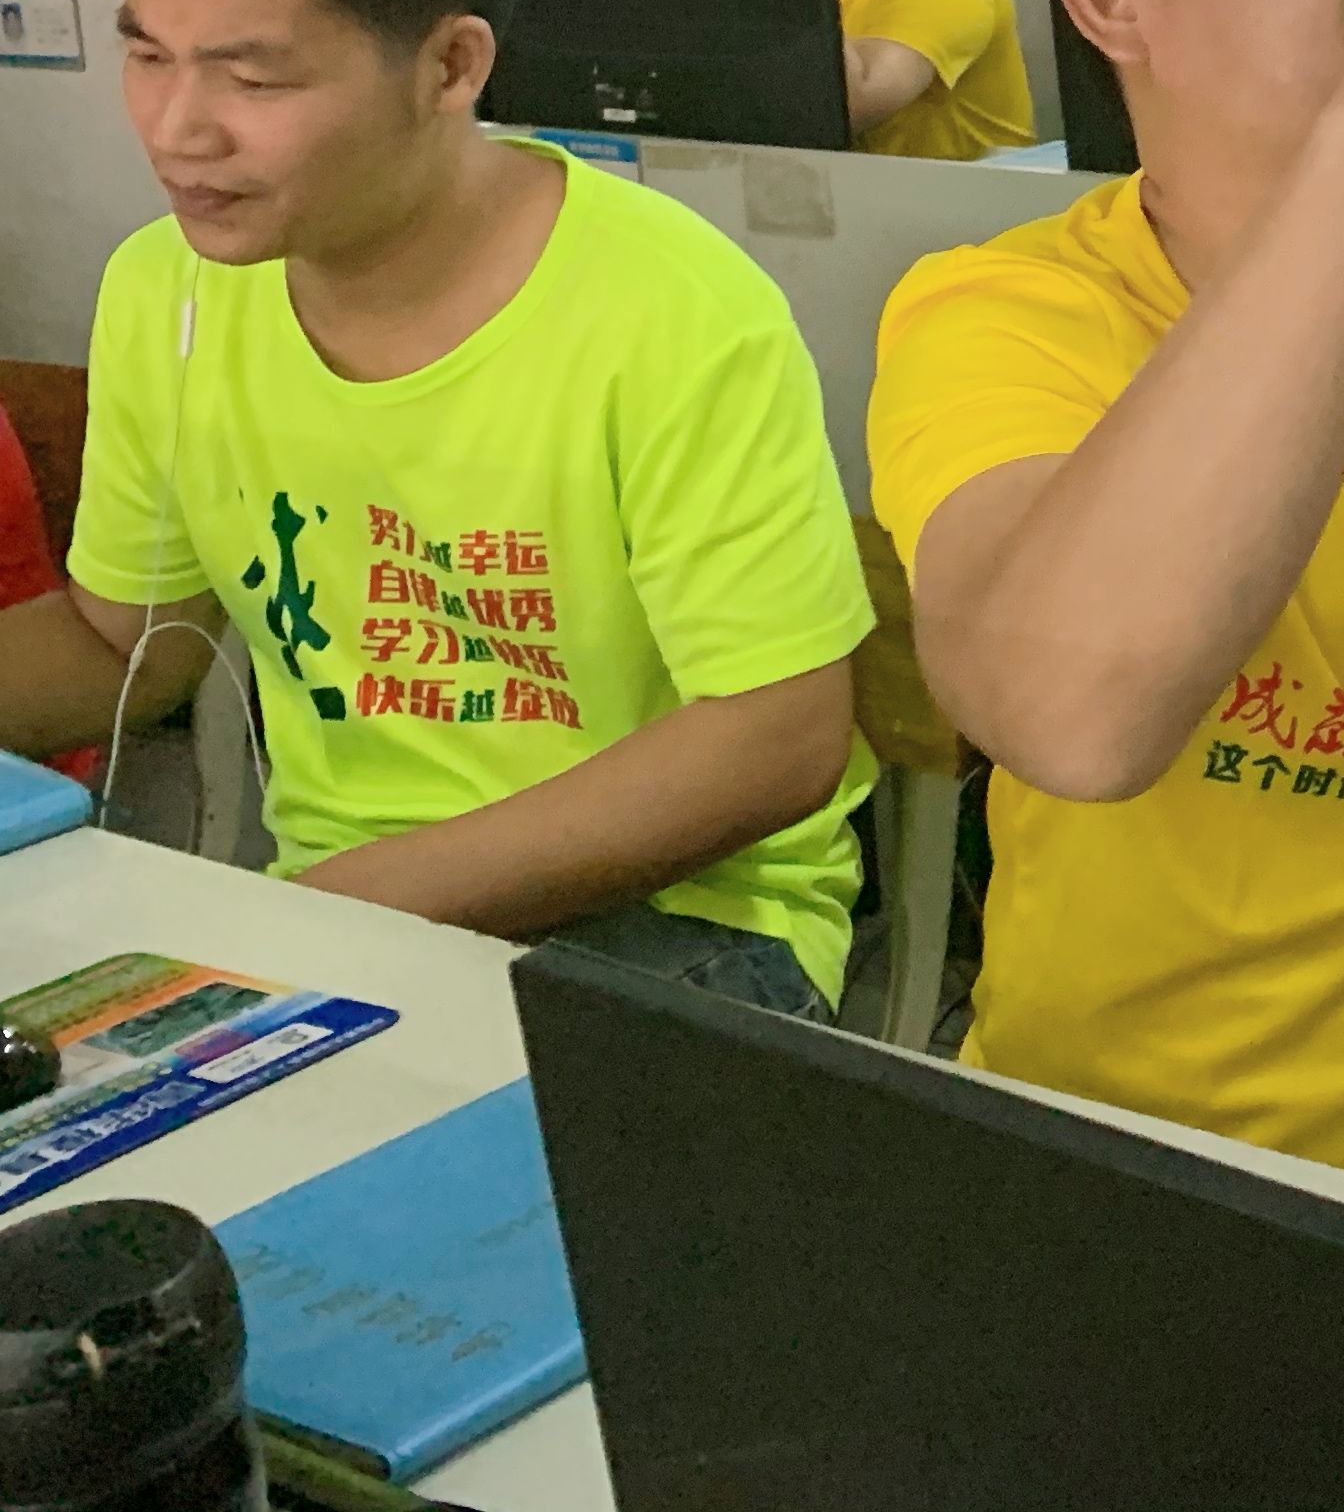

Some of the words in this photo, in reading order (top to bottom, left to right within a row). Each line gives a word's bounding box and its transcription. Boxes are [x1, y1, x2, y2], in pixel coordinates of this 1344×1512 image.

[367, 504, 550, 576] 努力越幸运
[367, 559, 557, 632] 自律越优秀
[361, 618, 569, 682] 学习越快乐
[356, 671, 584, 730] 快乐越绽放
